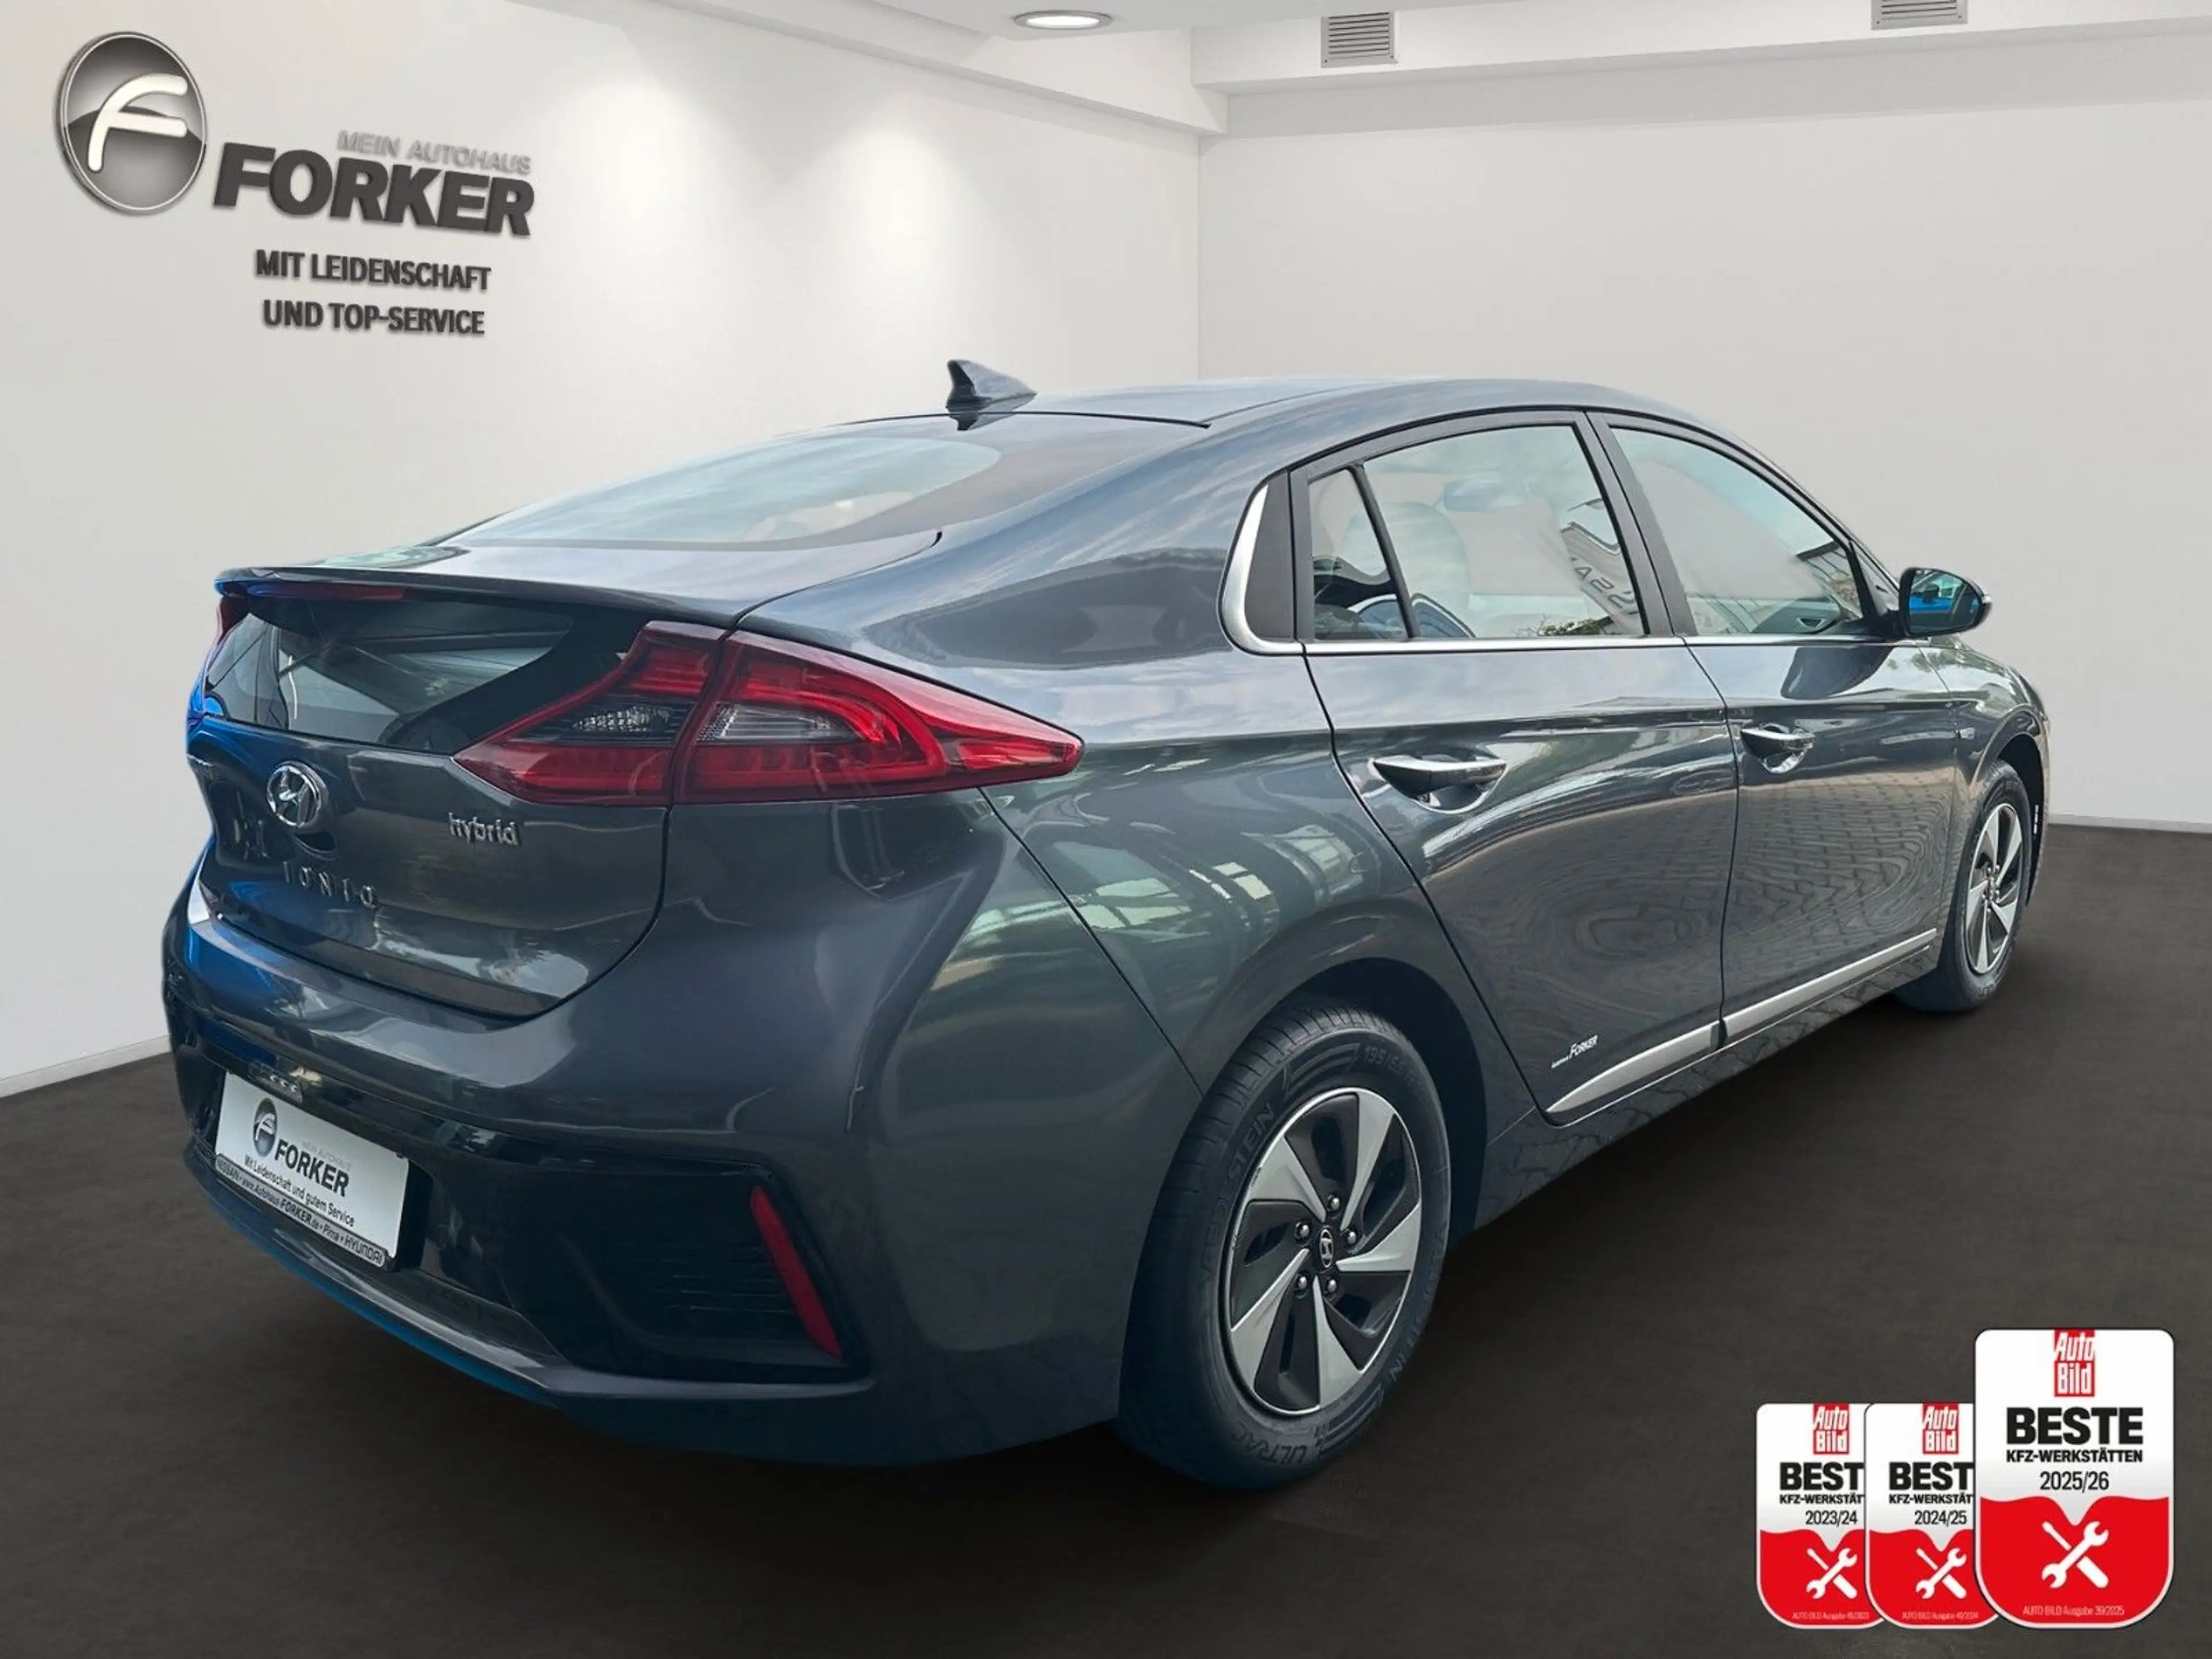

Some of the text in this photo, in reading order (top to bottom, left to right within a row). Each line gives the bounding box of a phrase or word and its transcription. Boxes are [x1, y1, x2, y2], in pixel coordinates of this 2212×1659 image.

[338, 130, 532, 174] MEIN AUTOHAUS
[214, 142, 535, 236] FORKER
[255, 249, 491, 290] MIT LEIDENSCHAFT
[263, 300, 486, 334] UND TOP-SERVICE
[448, 813, 519, 845] hybrid
[275, 1139, 349, 1197] FORKER
[328, 1203, 354, 1227] Service
[346, 1234, 382, 1265] HYUNDAI
